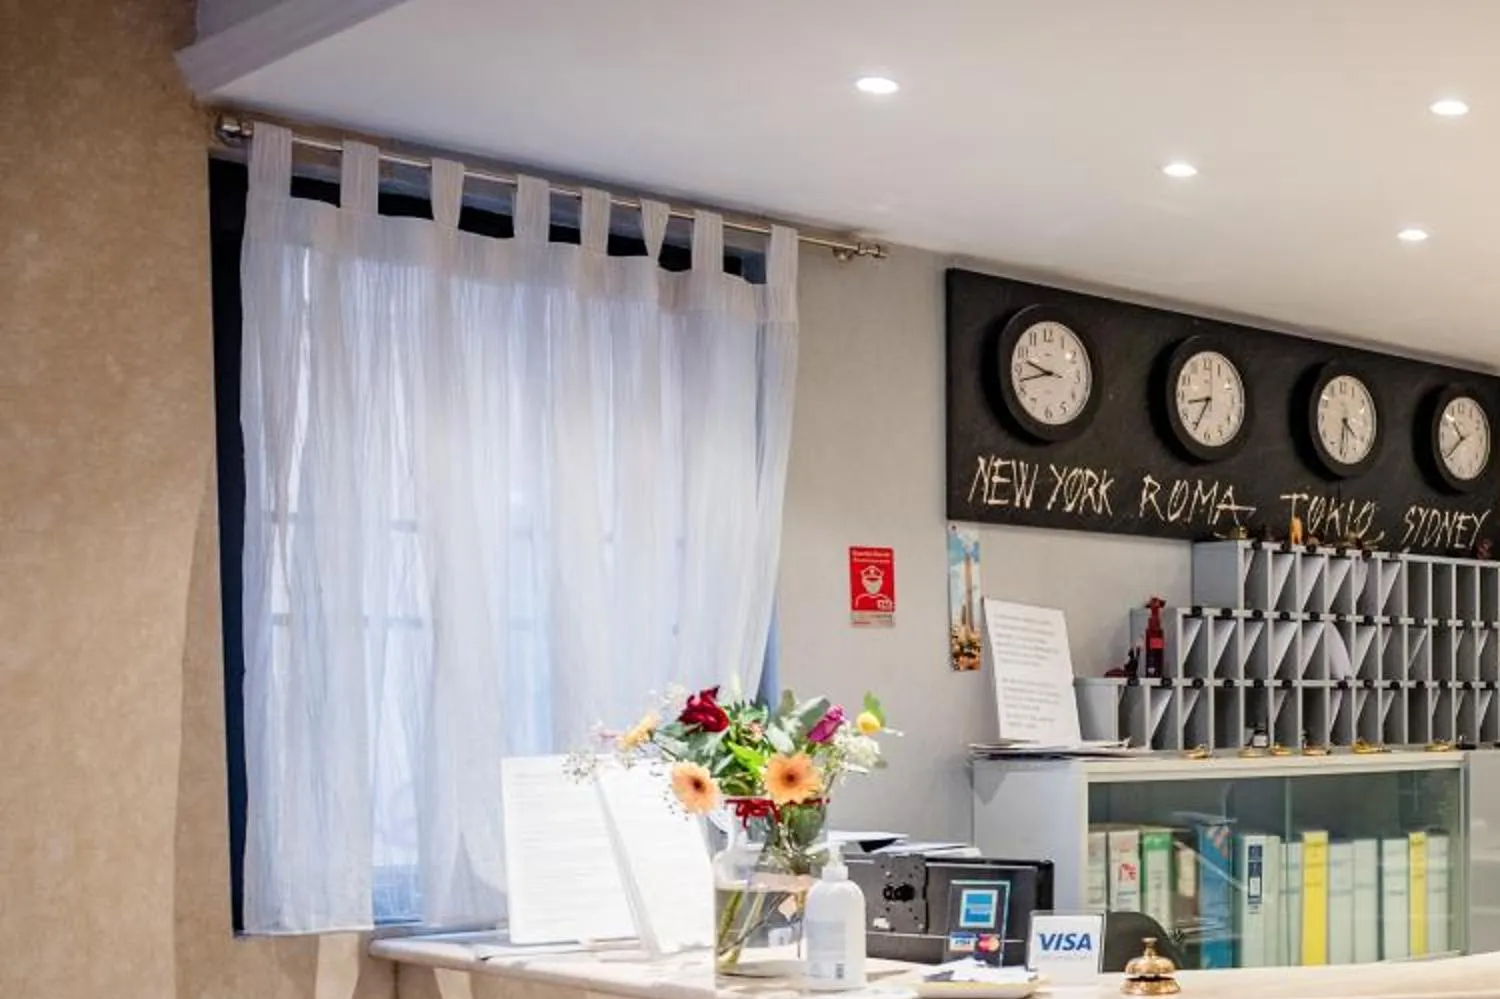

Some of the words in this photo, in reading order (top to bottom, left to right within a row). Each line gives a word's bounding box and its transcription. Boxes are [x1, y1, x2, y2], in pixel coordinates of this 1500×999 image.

[1043, 327, 1055, 343] 12
[968, 454, 1039, 509] NEW
[1046, 463, 1114, 517] YORK
[1139, 473, 1256, 526] ROMA
[1400, 503, 1492, 549] SYDNEY
[1038, 932, 1092, 951] VISA
